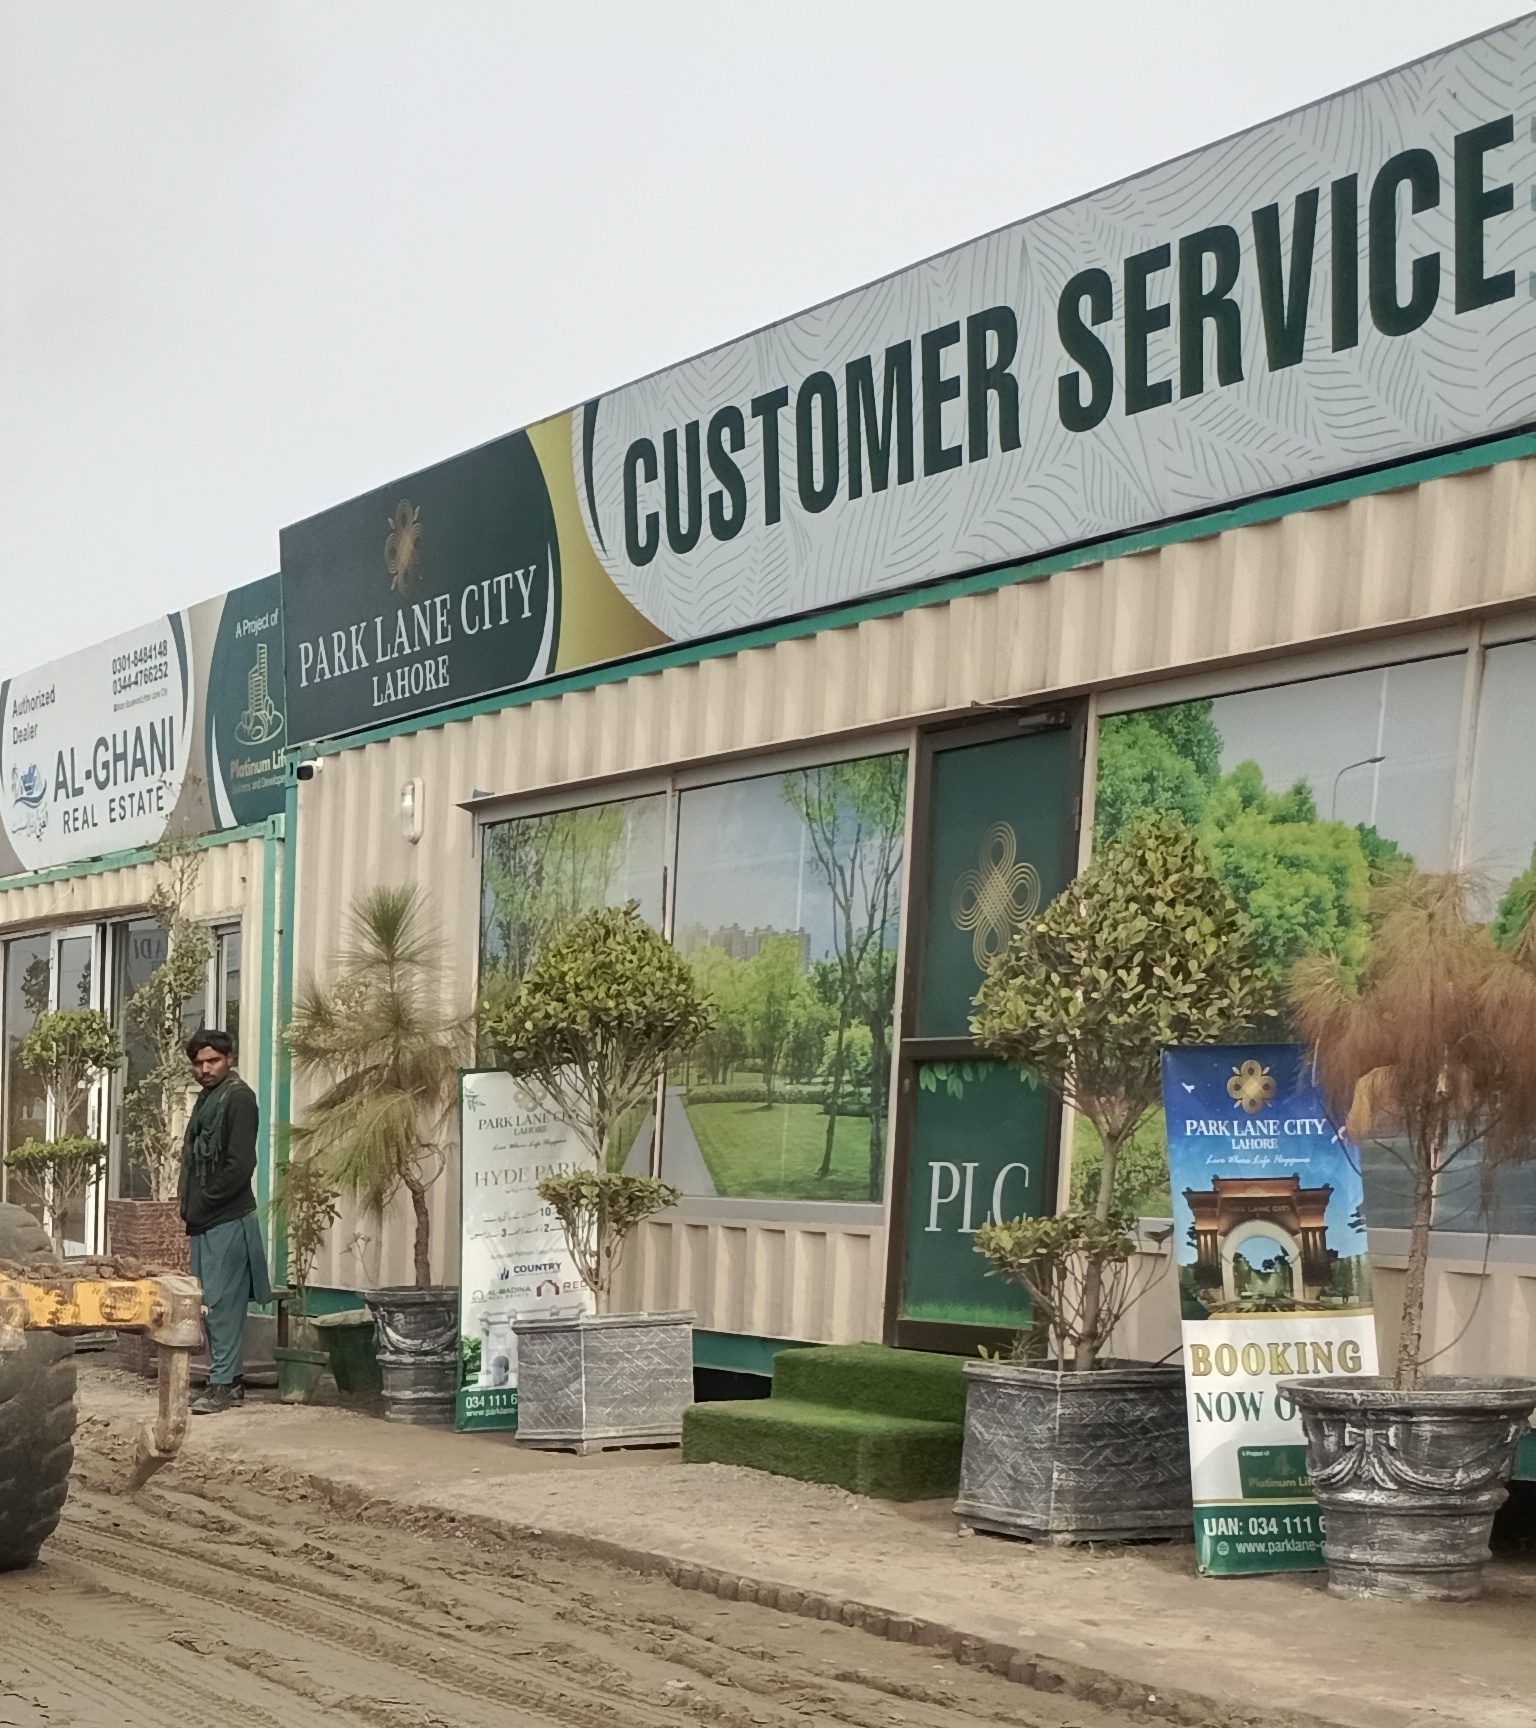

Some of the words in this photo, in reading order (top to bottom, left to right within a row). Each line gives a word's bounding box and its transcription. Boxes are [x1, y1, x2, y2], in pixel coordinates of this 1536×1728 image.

[622, 304, 1023, 568] CUSTOMER
[1056, 113, 1516, 433] SERVICE
[235, 622, 242, 638] A
[243, 612, 273, 637] Project
[271, 608, 279, 626] of
[298, 621, 369, 687] PARK
[374, 594, 452, 663] LANE
[460, 564, 537, 635] CITY
[112, 639, 168, 675] 0301-8484148
[371, 655, 449, 707] LAHORE
[12, 684, 56, 719] Authorized
[13, 722, 38, 745] Dealer
[54, 715, 175, 803] AL-GHANI
[230, 757, 271, 779] Platinum
[273, 747, 286, 770] Lif
[63, 803, 98, 834] REAL
[109, 785, 164, 824] ESTATE
[478, 1115, 513, 1130] PARK
[516, 1113, 550, 1127] LANE
[514, 1125, 548, 1136] LAHORE
[1185, 1119, 1230, 1136] PARK
[1233, 1119, 1279, 1137] LANE
[1284, 1118, 1327, 1136] CITY
[1232, 1138, 1279, 1150] LAHORE
[475, 1167, 528, 1187] HYDE
[535, 1161, 583, 1180] PARK
[925, 1161, 1029, 1233] PLC
[539, 1207, 551, 1217] 10
[513, 1262, 562, 1273] COUNTRY
[488, 1286, 531, 1296] AL-MADINA
[563, 1281, 587, 1290] RED
[1189, 1340, 1362, 1377] BOOKING
[466, 1395, 485, 1409] 034
[489, 1394, 506, 1406] 111
[1194, 1391, 1264, 1422] NOW
[1249, 1477, 1297, 1488] Platinum
[1203, 1517, 1243, 1536] UAN:
[1248, 1517, 1278, 1535] 034
[1282, 1516, 1312, 1534] 111
